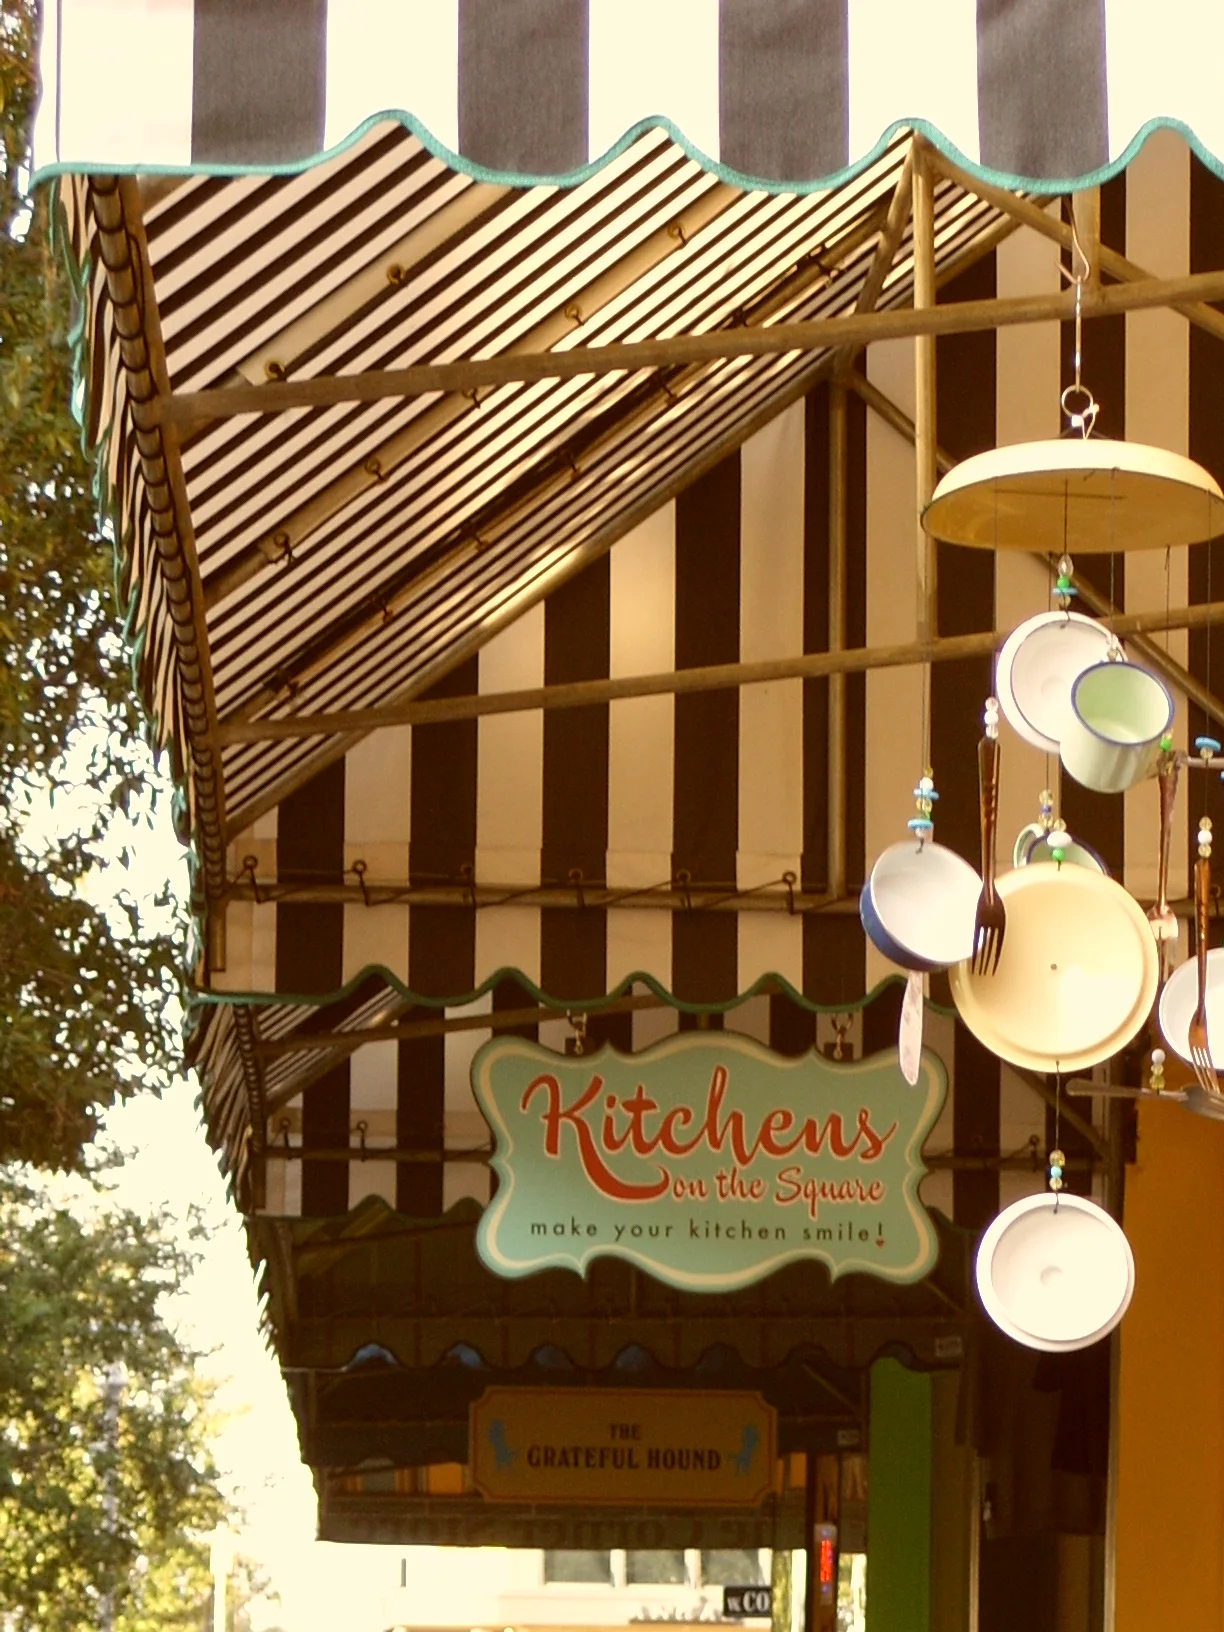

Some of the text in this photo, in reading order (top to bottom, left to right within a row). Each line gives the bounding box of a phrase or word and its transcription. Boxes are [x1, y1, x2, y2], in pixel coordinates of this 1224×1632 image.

[520, 1066, 900, 1202] Kitchens
[672, 1165, 887, 1221] on the Square
[530, 1217, 885, 1248] make your kitchen smile!
[609, 1423, 641, 1441] THE
[526, 1446, 722, 1470] GRATEFUL HOUND
